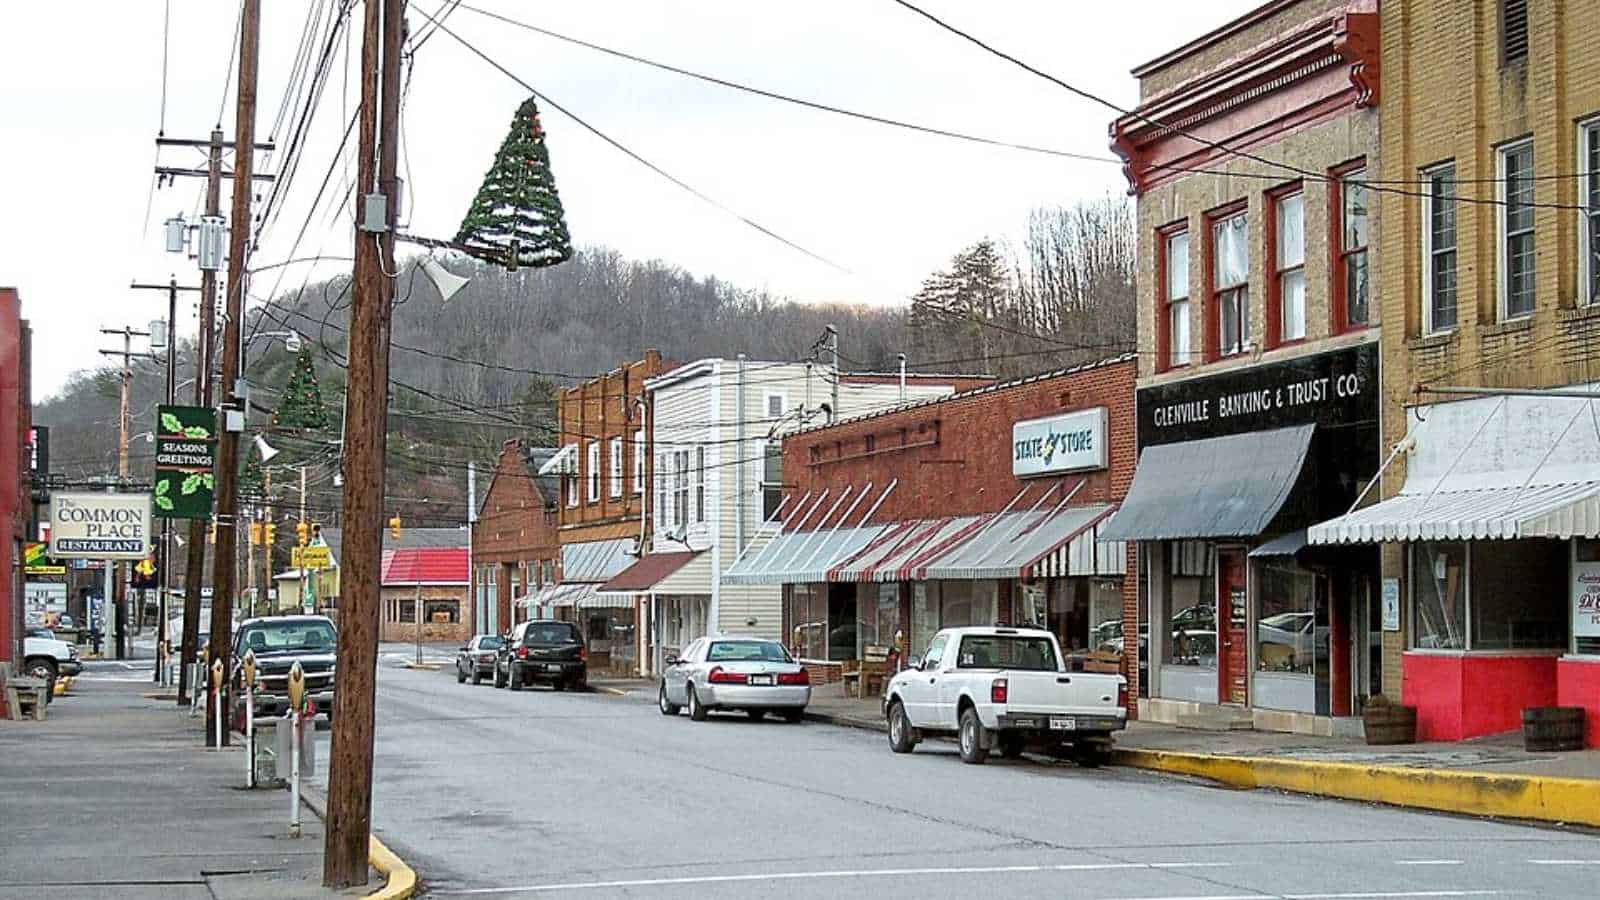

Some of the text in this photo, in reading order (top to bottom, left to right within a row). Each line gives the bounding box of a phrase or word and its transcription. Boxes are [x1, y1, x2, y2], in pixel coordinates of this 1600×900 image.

[1154, 373, 1361, 427] GLENVILLE BANKING & TRUST CO.
[162, 442, 208, 454] SEASONS
[1015, 429, 1092, 461] STATE STORE
[157, 453, 213, 466] GREETINGS
[58, 507, 143, 523] COMMON
[86, 523, 143, 538] PLACE
[59, 540, 141, 551] RESTAURANT
